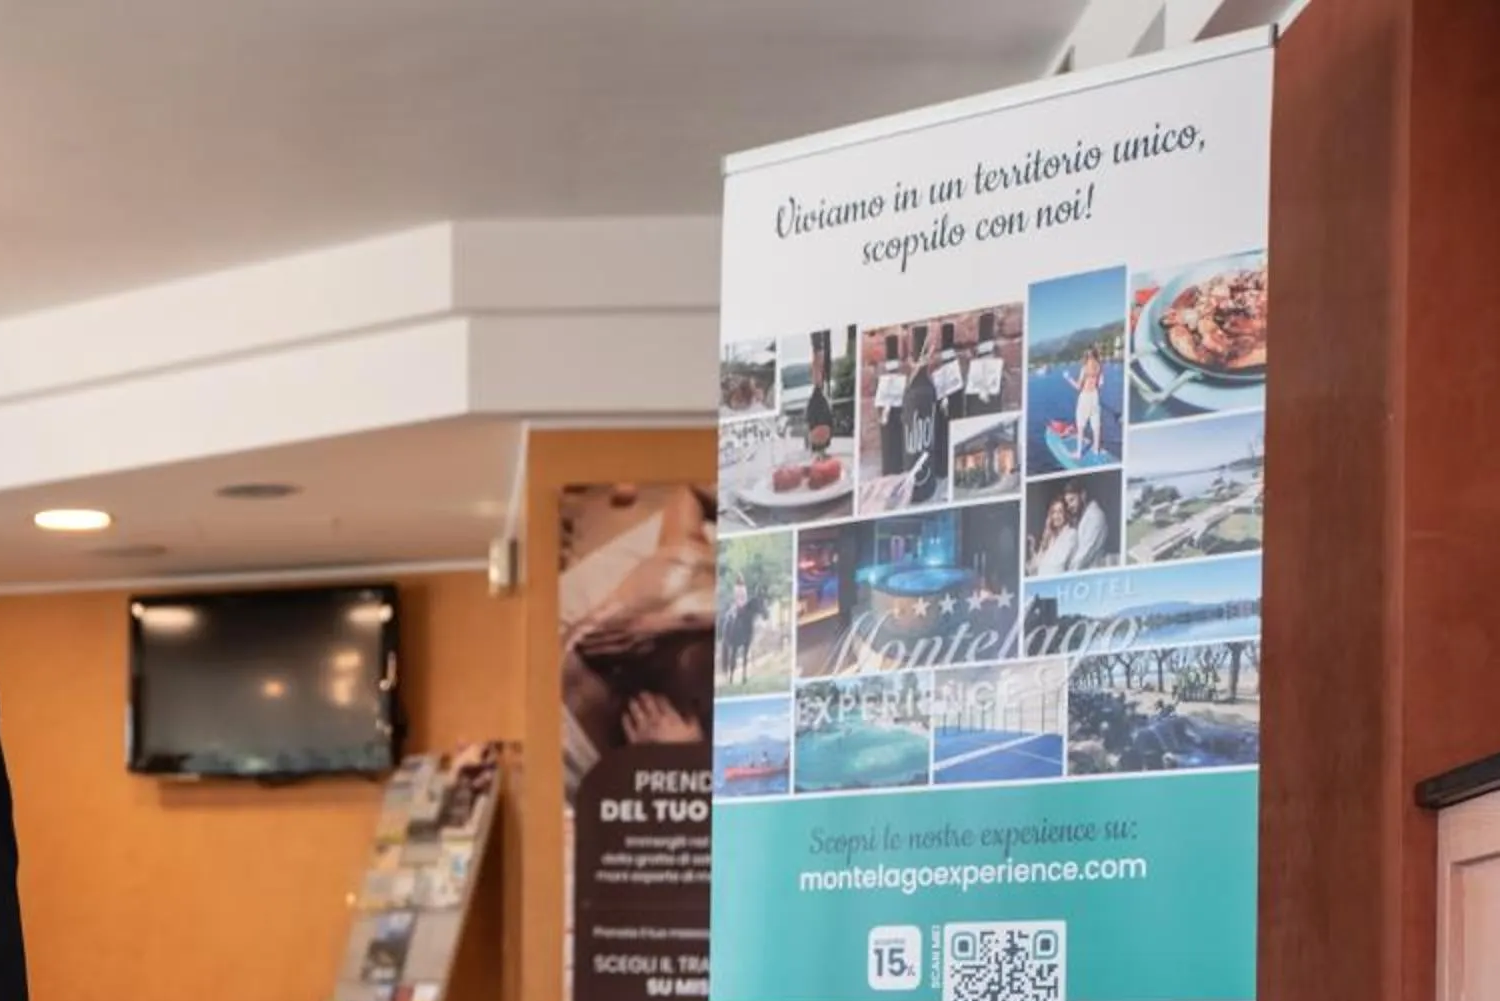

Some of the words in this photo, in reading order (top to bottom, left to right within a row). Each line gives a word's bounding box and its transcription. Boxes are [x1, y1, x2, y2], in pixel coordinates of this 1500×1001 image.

[775, 195, 885, 240] Viviamo
[893, 181, 920, 213] in
[928, 177, 965, 206] un
[974, 139, 1103, 196] territorio
[1112, 121, 1206, 165] unico,
[861, 212, 967, 273] scoprilo
[974, 208, 1028, 242] con
[1036, 181, 1096, 229] noi!
[1056, 575, 1137, 600] HOTEL
[812, 608, 1144, 690] Montelago
[600, 799, 649, 822] DEL
[652, 799, 709, 822] TUO
[808, 825, 877, 866] Scopri
[882, 822, 902, 851] le
[908, 822, 975, 850] nostre
[980, 817, 1098, 858] experience
[1103, 819, 1139, 841] su:
[798, 856, 1148, 895] montelagoexperience.com
